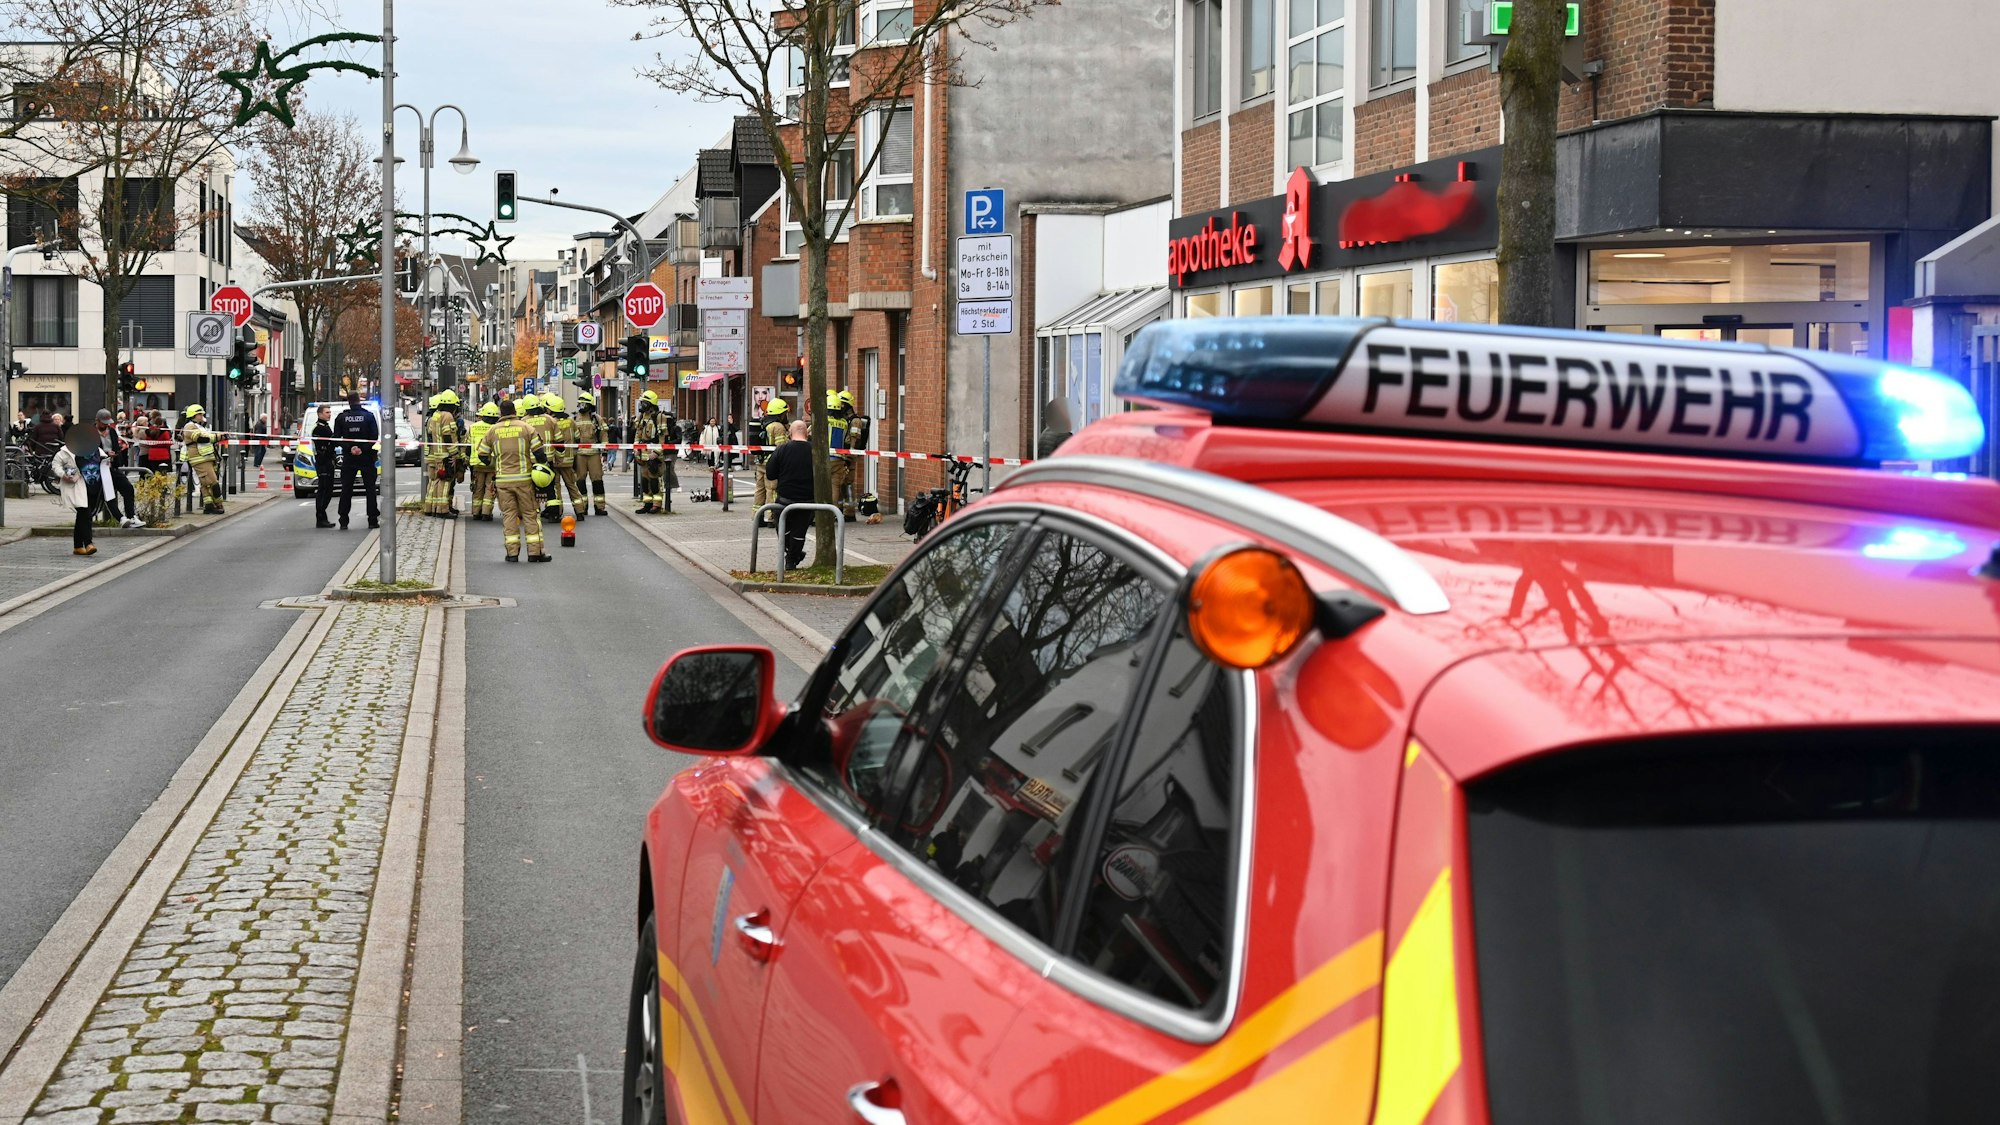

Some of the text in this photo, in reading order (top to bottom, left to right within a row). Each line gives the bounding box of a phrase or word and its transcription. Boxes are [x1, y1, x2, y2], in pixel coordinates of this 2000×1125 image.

[971, 195, 992, 229] P
[977, 243, 991, 251] mit
[1168, 211, 1257, 287] apotheke
[961, 252, 1008, 262] Parkschein
[960, 268, 984, 279] Mo-Fr
[960, 282, 970, 292] Sa
[213, 298, 249, 316] STOP
[627, 296, 661, 315] STOP
[960, 307, 1008, 316] Höchstparkdauer
[972, 319, 996, 328] 2 Std.
[203, 324, 219, 338] 20
[584, 327, 593, 335] 20
[652, 340, 667, 348] dm
[199, 346, 221, 354] ZONE
[686, 373, 699, 381] dm
[1362, 343, 1814, 443] FEUERWEHR
